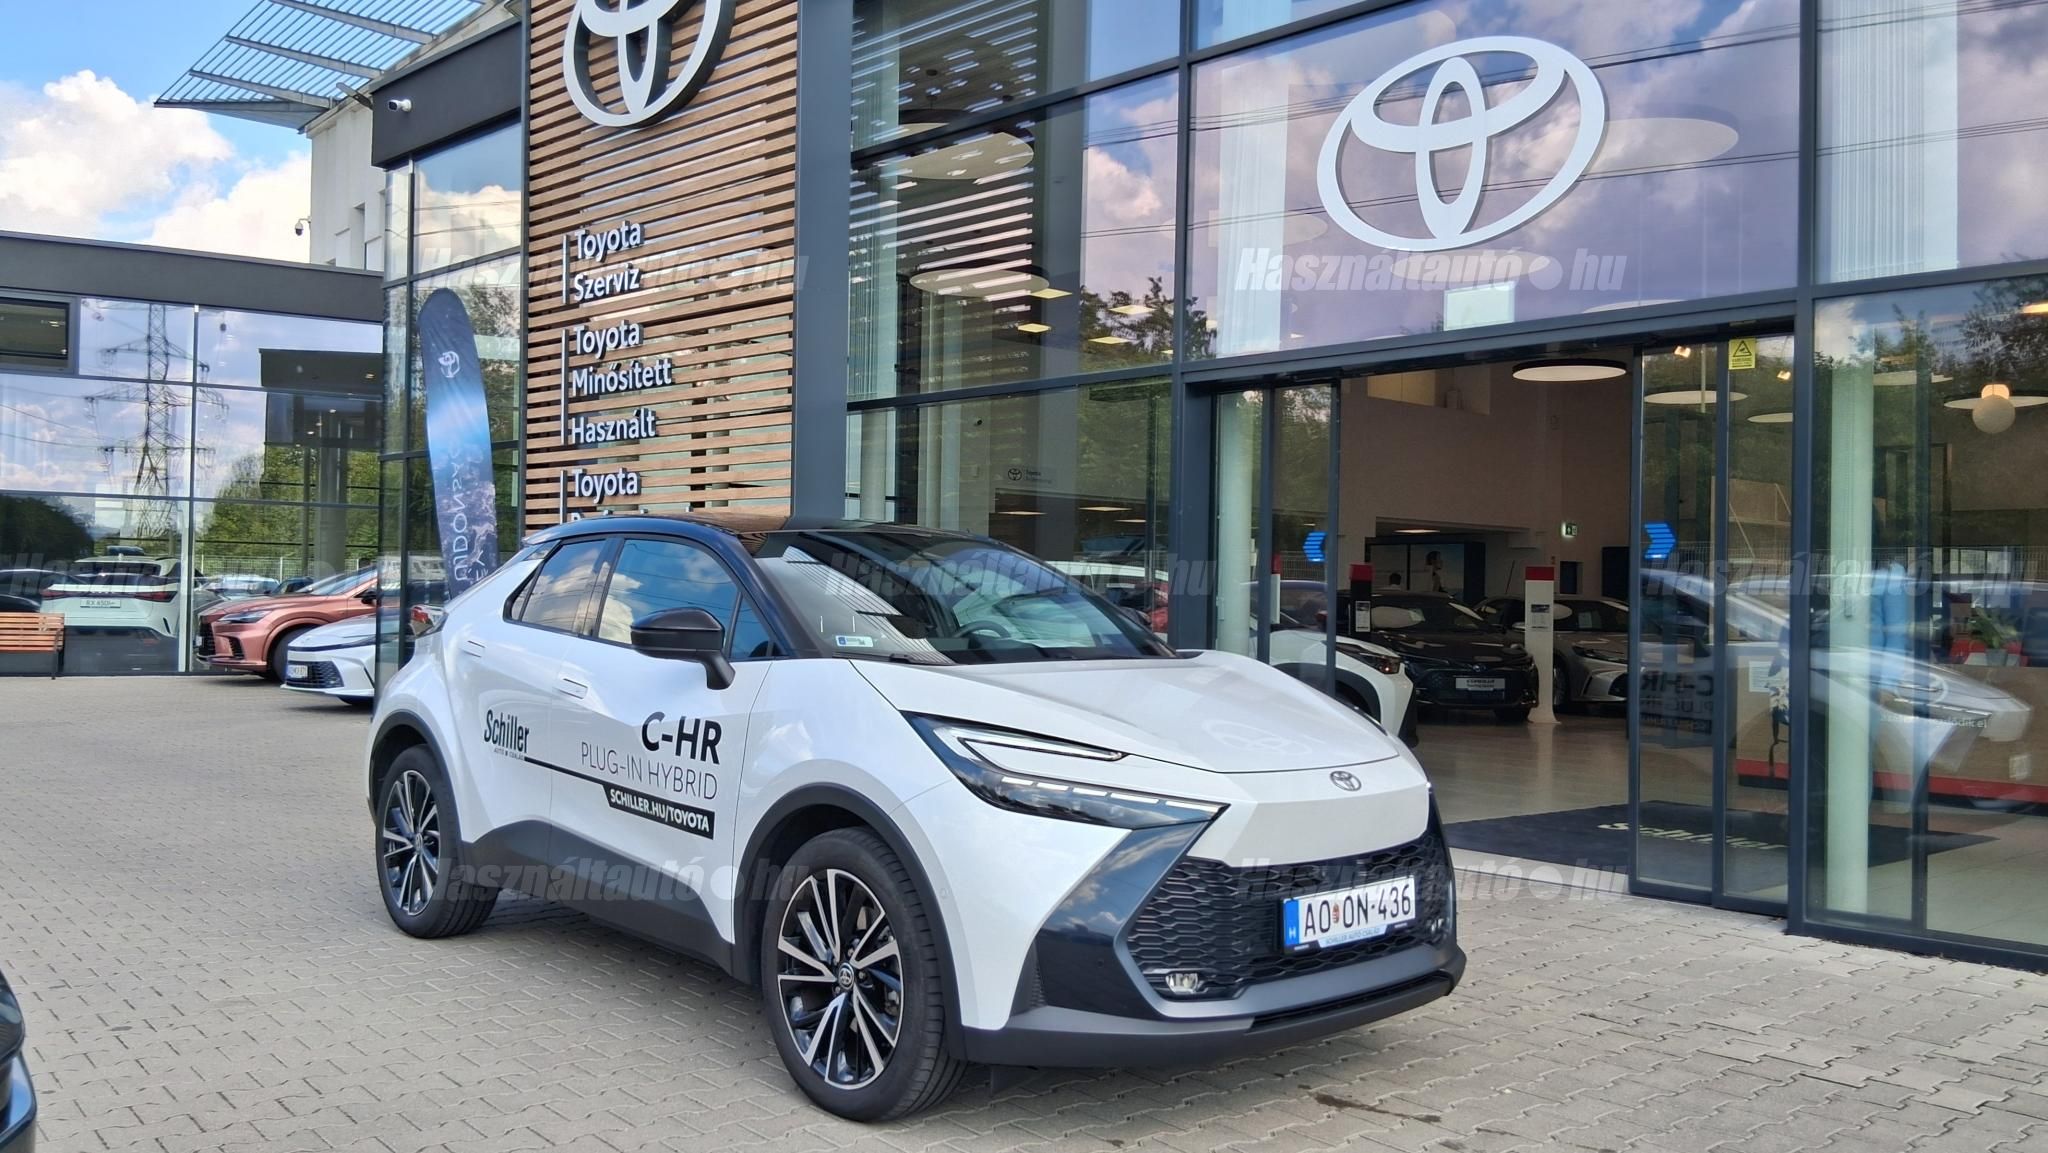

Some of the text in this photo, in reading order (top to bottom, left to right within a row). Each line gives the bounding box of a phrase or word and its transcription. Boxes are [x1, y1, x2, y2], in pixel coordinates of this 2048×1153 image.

[575, 220, 642, 262] Toyota
[574, 264, 641, 301] Szerviz
[573, 320, 641, 359] Toyota
[572, 360, 672, 397] Minősített
[571, 408, 657, 443] Használt
[572, 469, 639, 503] Toyota
[483, 708, 530, 754] Schiller
[641, 711, 722, 765] C-HR
[581, 741, 718, 800] PLUG-IN HYBRID
[610, 788, 710, 833] SCHILLER.HU/TOYOTA
